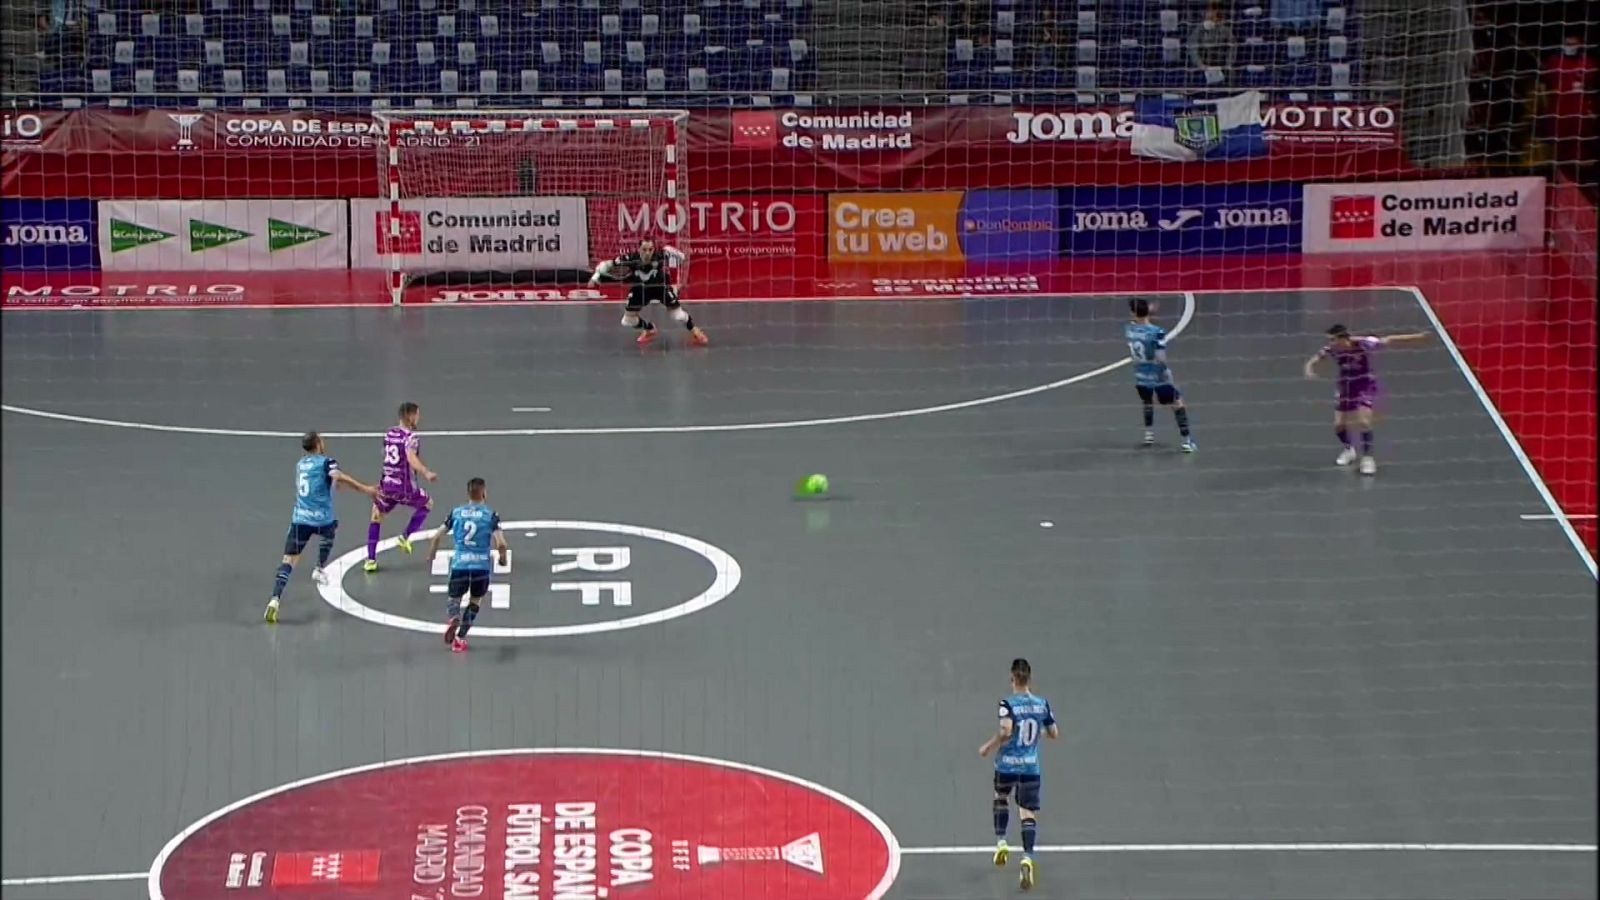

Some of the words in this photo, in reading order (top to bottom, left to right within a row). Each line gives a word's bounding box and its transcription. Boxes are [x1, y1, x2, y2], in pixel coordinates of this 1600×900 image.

[226, 119, 286, 133] COPA
[292, 119, 321, 133] DE
[781, 111, 912, 128] Comunidad
[226, 134, 342, 147] COMUNIDAD
[347, 136, 373, 147] DE
[378, 136, 450, 147] MADRID
[782, 131, 813, 148] de
[822, 132, 912, 150] Madrid
[1381, 190, 1518, 211] Comunidad
[427, 210, 560, 228] Comunidad
[835, 202, 915, 229] Crea
[1381, 219, 1413, 237] de
[1423, 214, 1517, 235] Madrid
[427, 235, 458, 253] de
[469, 234, 560, 253] Madrid
[835, 229, 869, 251] tu
[877, 224, 948, 251] web
[464, 520, 477, 545] 2
[1016, 718, 1039, 746] 10
[555, 802, 596, 830] DE
[413, 824, 448, 884] MADRID
[451, 805, 488, 897] COMUNIDAD
[609, 828, 653, 887] COPA
